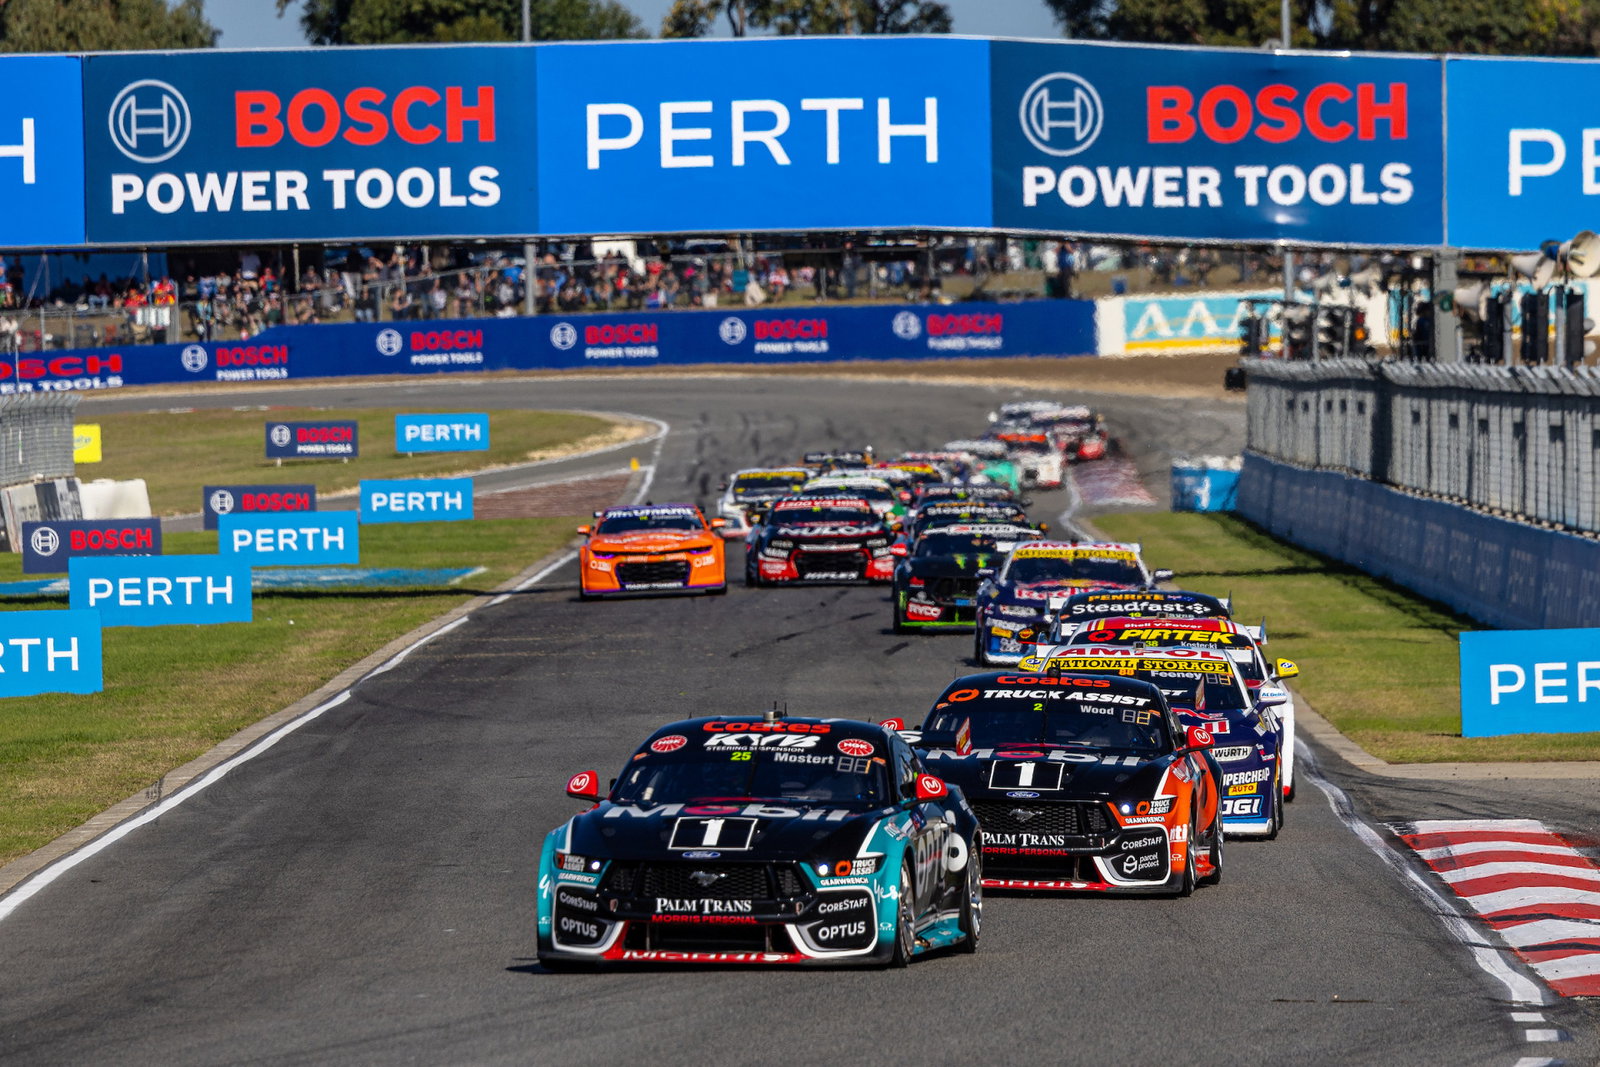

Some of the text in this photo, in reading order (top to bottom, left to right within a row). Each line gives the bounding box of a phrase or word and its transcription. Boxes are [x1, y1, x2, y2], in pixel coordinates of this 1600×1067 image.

[235, 86, 496, 147] BOSCH
[1147, 83, 1408, 143] BOSCH
[587, 97, 938, 170] PERTH
[111, 166, 501, 214] POWER TOOLS
[1022, 163, 1413, 207] POWER TOOLS
[754, 319, 828, 339] BOSCH
[927, 314, 1003, 336] BOSCH
[411, 330, 483, 350] BOSCH
[585, 323, 658, 344] BOSCH
[216, 345, 289, 366] BOSCH
[39, 376, 124, 392] TOOLS
[297, 427, 353, 442] BOSCH
[405, 423, 481, 441] PERTH
[242, 493, 310, 511] BOSCH
[371, 491, 463, 512] PERTH
[777, 526, 882, 536] NULON
[70, 528, 153, 550] BOSCH
[232, 527, 345, 552] PERTH
[89, 575, 233, 606] PERTH
[1088, 594, 1165, 602] PENRITE
[908, 604, 942, 617] RYCO
[1073, 602, 1186, 614] Steadfast
[1119, 629, 1235, 644] PIRTEK
[0, 636, 79, 673] TH
[1056, 647, 1224, 660] AMPOL
[1050, 658, 1134, 669] NATIONAL
[1144, 660, 1225, 673] STORAGE
[996, 676, 1111, 688] Coates
[1119, 669, 1202, 681] 88 Feeney
[983, 690, 1065, 700] TRUCK
[1068, 690, 1151, 706] ASSIST
[1033, 703, 1114, 715] 2 Wood
[703, 721, 831, 734] Coates
[658, 738, 682, 746] NGK
[703, 733, 821, 748] KYB
[731, 752, 834, 765] 25 Mostert
[926, 748, 1140, 766] Mobil
[1215, 748, 1248, 758] WÜRTH
[1013, 762, 1035, 787] 1
[1232, 785, 1254, 793] AUTO
[604, 803, 850, 822] Mobil
[1148, 806, 1169, 815] ASSIST
[1124, 816, 1166, 824] GEARWRENCH
[700, 818, 722, 846] 1
[982, 832, 1065, 846] PALM TRANS
[1019, 848, 1068, 856] PERSONAL
[1139, 852, 1159, 863] parcel
[851, 858, 876, 867] TRUCK
[1138, 860, 1160, 871] protect
[558, 872, 597, 884] GEARWRENCH
[850, 867, 875, 876] ASSIST
[820, 877, 869, 886] GEARWRENCH
[656, 897, 752, 914] PALM TRANS
[651, 914, 757, 924] MORRIS PERSONAL
[560, 916, 598, 938] OPTUS
[818, 921, 866, 941] OPTUS
